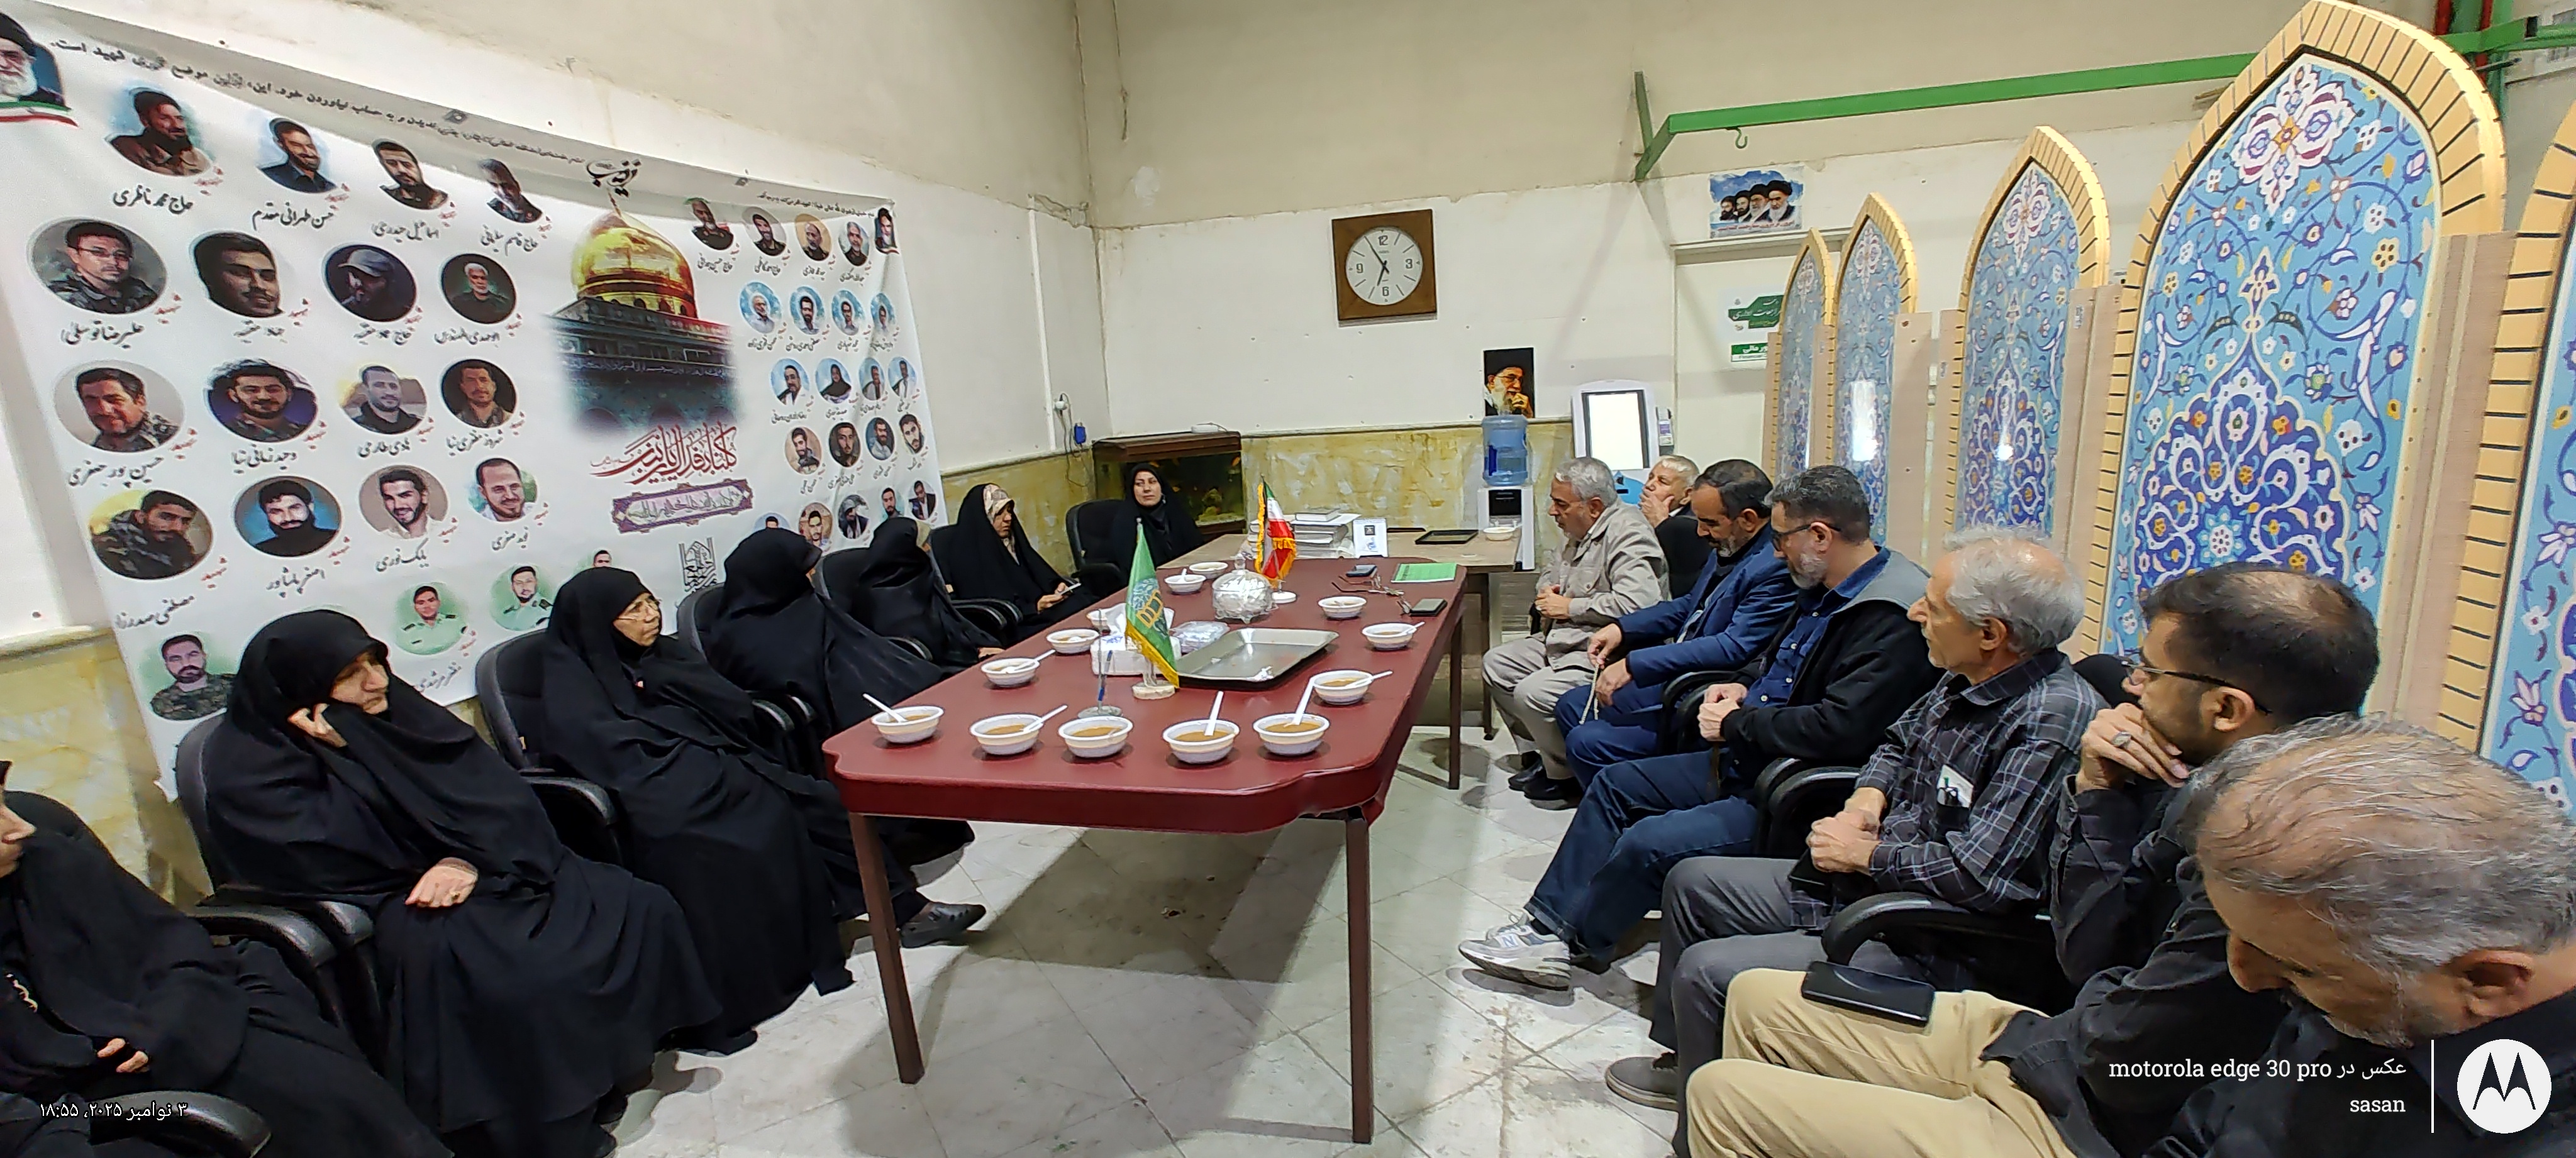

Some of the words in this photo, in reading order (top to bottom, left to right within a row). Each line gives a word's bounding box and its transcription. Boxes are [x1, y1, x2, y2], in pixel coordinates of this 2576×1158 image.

[113, 185, 151, 207] ناظری
[169, 194, 193, 214] حاج
[252, 202, 279, 231] مقدم
[311, 212, 334, 228] حسن
[1377, 234, 1389, 246] 12
[1356, 263, 1363, 273] 9
[1405, 258, 1413, 269] 3
[1382, 286, 1389, 297] 6
